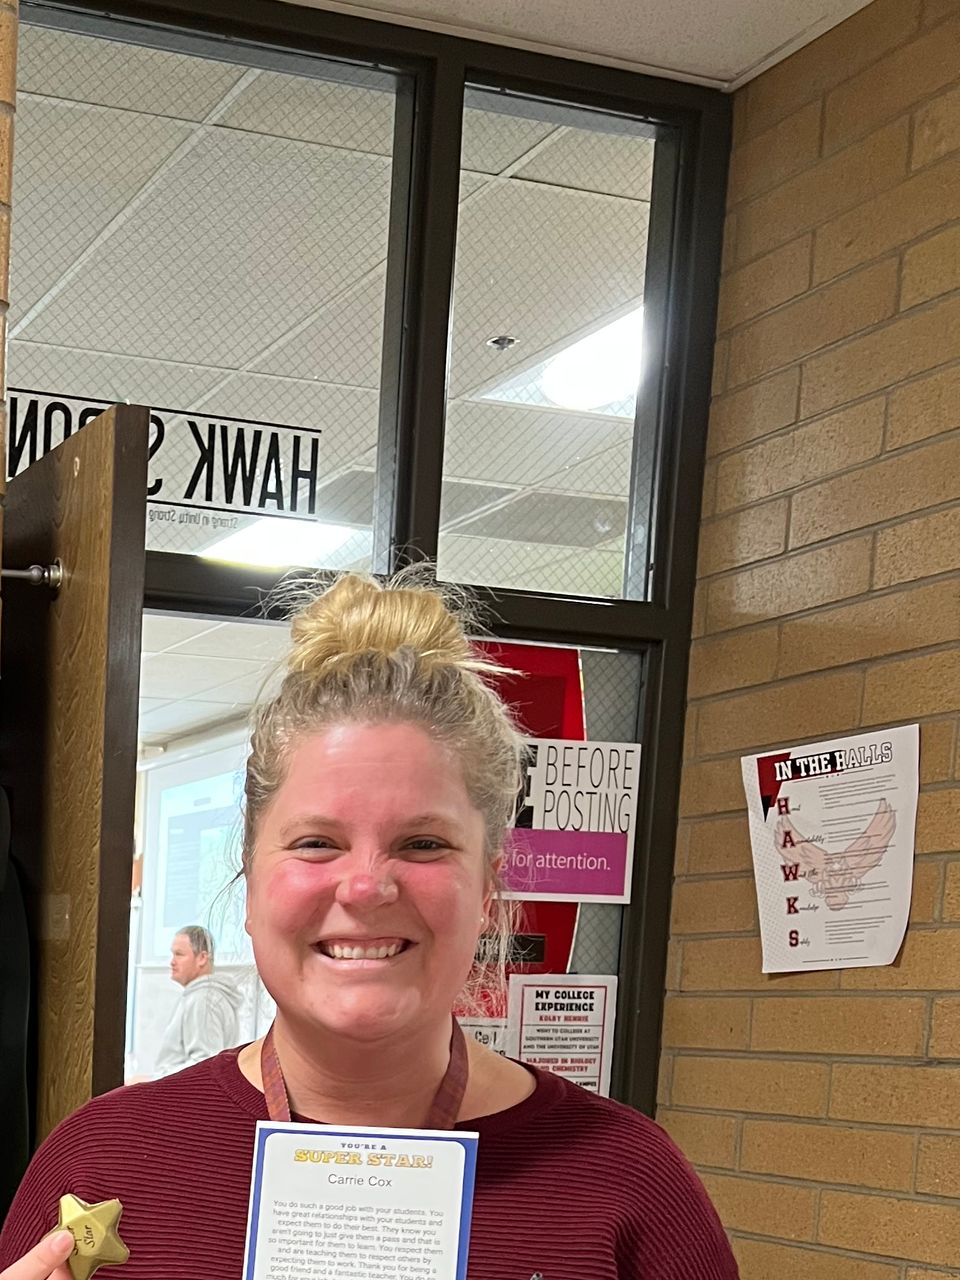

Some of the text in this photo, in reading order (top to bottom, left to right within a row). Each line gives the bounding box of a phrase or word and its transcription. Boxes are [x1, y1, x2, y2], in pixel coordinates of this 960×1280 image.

[546, 746, 634, 790] BEFORE
[774, 742, 893, 781] IN THE HALLS
[542, 790, 632, 833] POSTING
[512, 853, 532, 867] for
[536, 852, 611, 871] attention.
[536, 990, 595, 1000] MY COLLEGE
[535, 1002, 594, 1012] EXPERIENCE
[294, 1148, 433, 1169] SUPER STAR!
[327, 1173, 392, 1187] Carrie Cox
